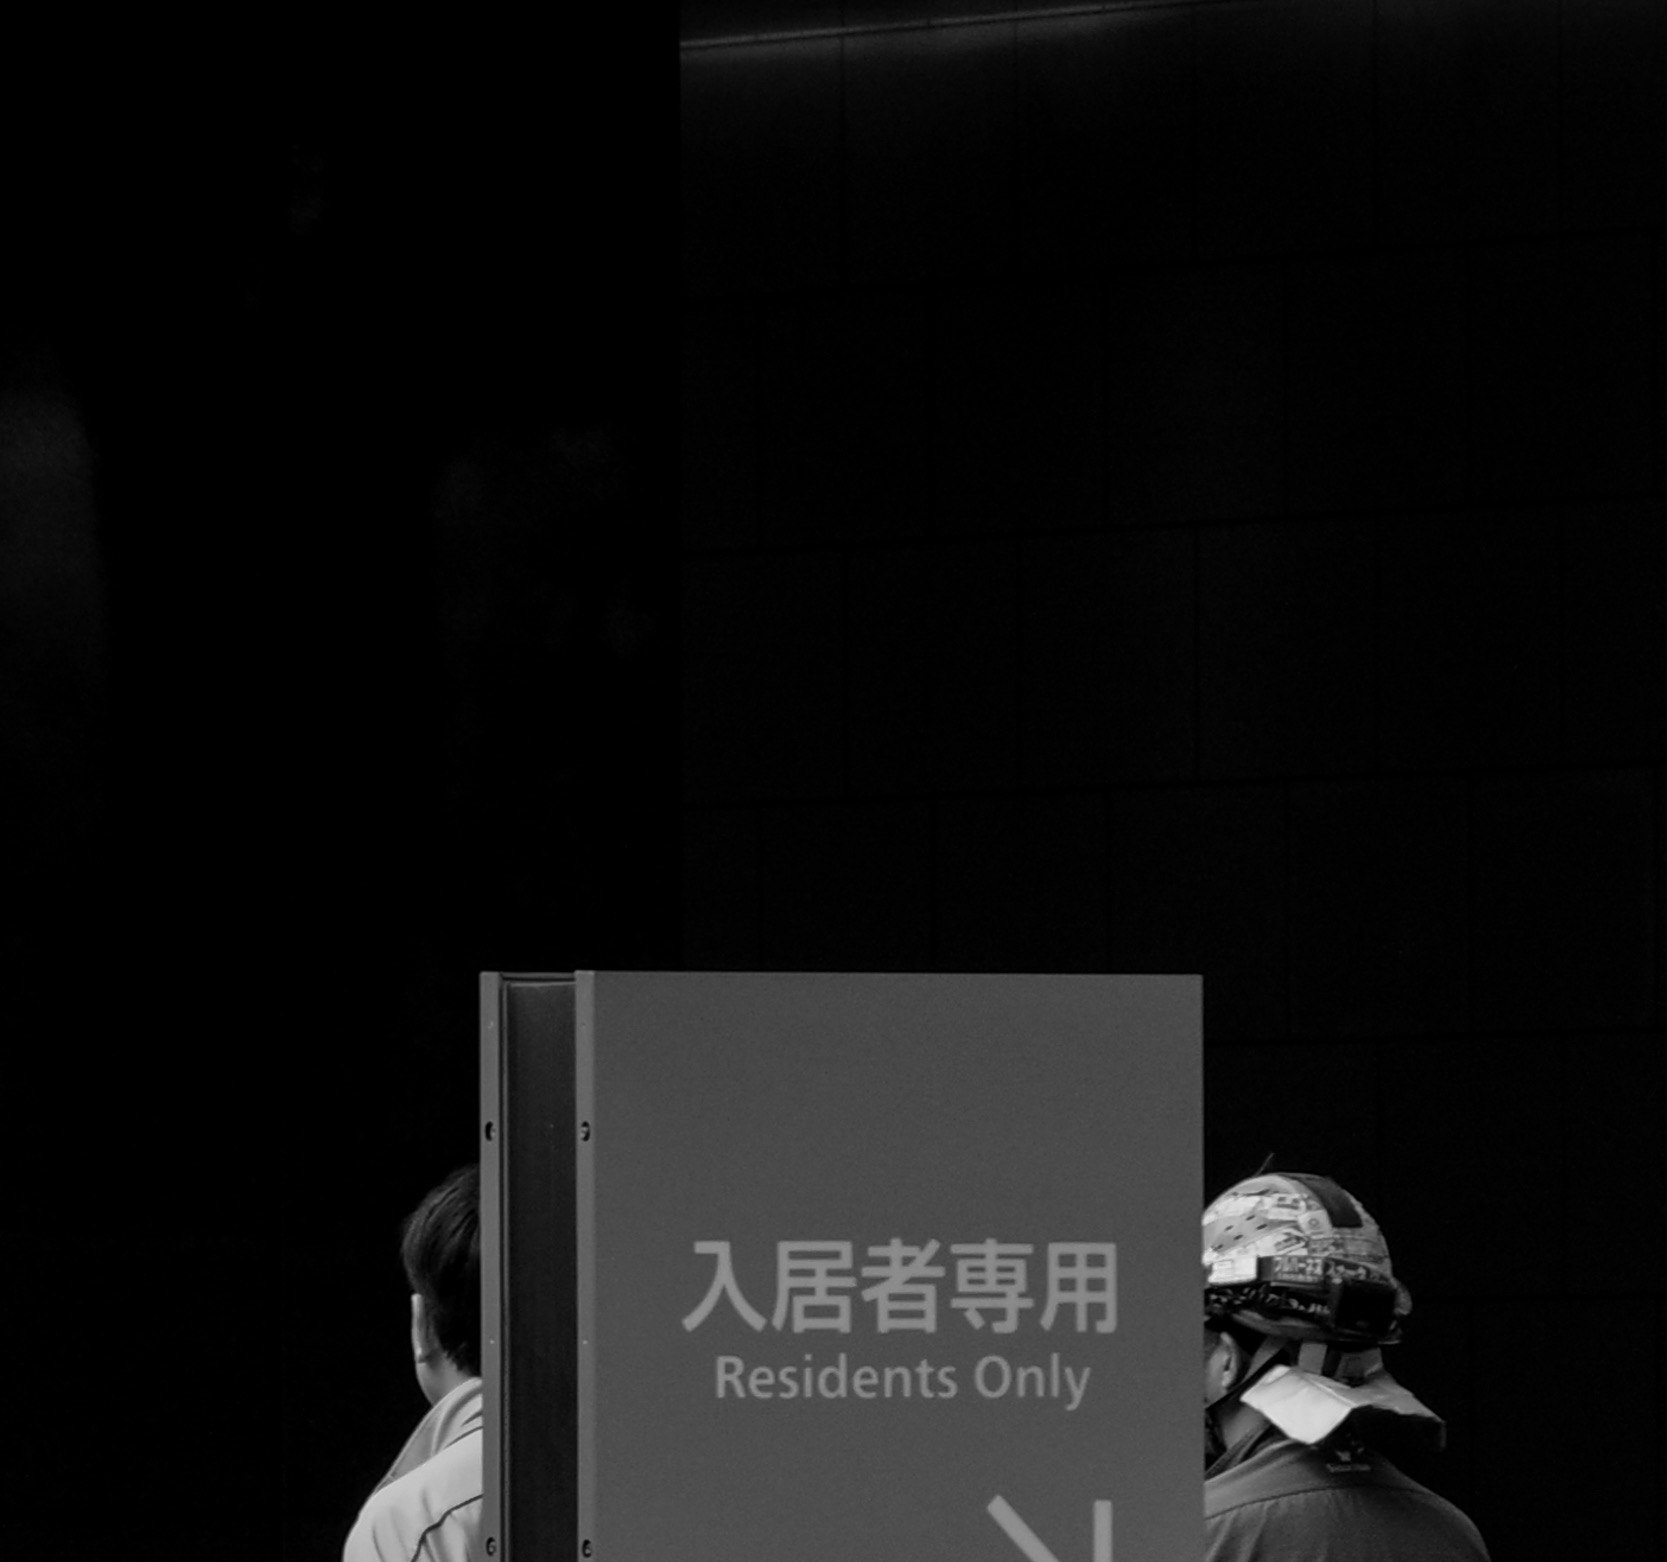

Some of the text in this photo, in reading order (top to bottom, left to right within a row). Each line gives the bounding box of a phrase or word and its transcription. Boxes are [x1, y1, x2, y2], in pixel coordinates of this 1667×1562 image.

[682, 1238, 1117, 1334] 入居者専用
[716, 1353, 1091, 1411] Residents Only
